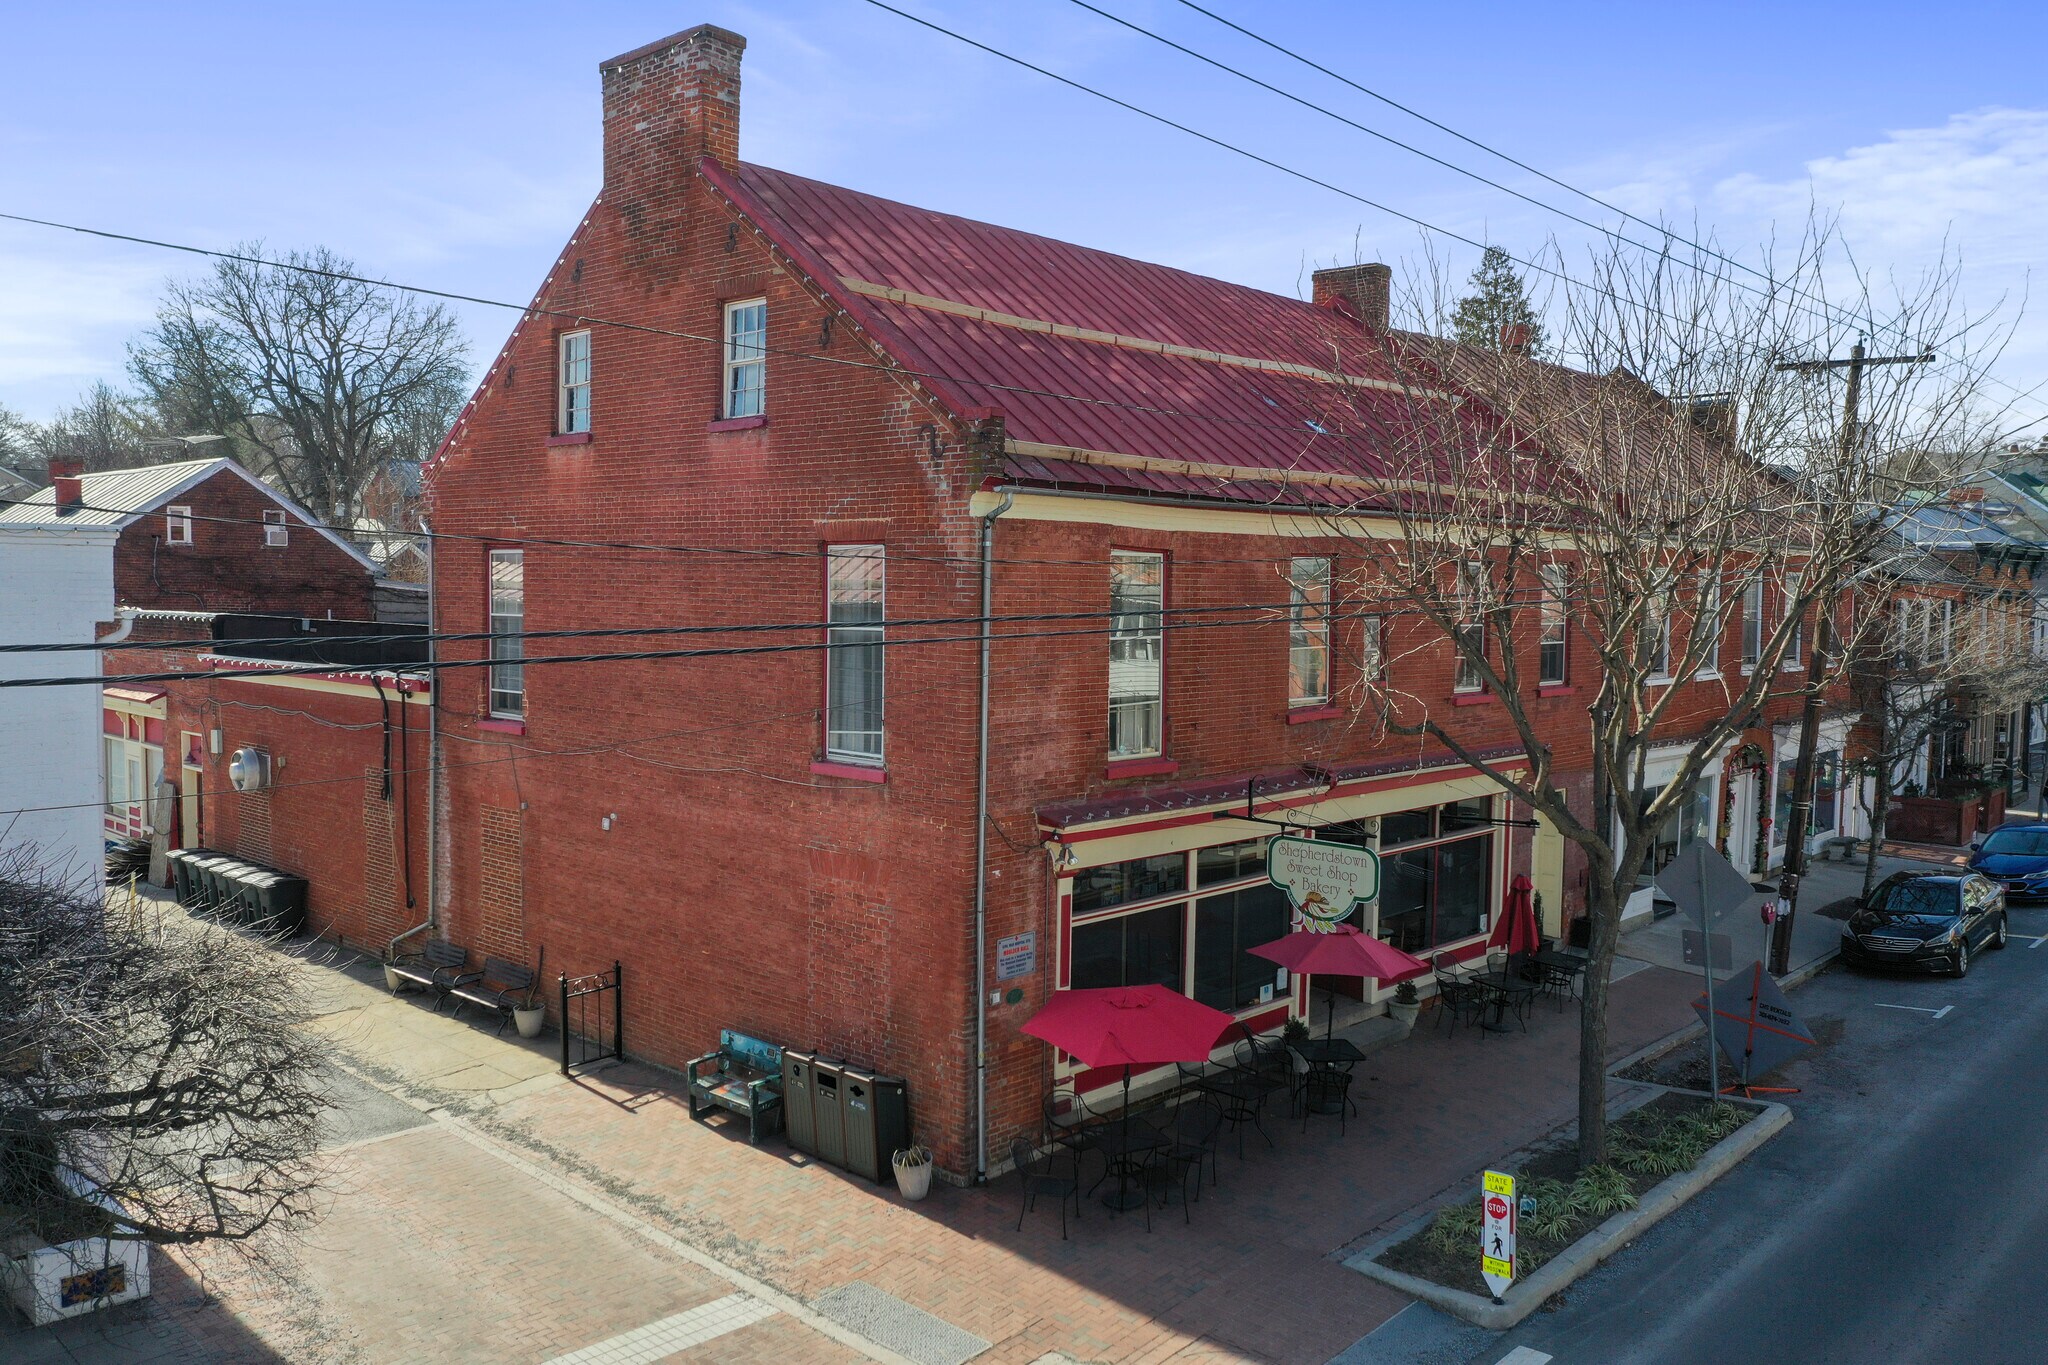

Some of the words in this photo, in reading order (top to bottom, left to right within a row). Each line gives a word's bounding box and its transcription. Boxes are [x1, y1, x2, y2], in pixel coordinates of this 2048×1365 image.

[1278, 842, 1367, 868] Shepherdstown
[1287, 859, 1322, 877] Sweet
[1326, 865, 1357, 886] Shop
[1302, 877, 1340, 899] Bakery
[1487, 1174, 1507, 1186] STATE
[1490, 1184, 1504, 1192] LAW
[1488, 1202, 1506, 1213] STOP
